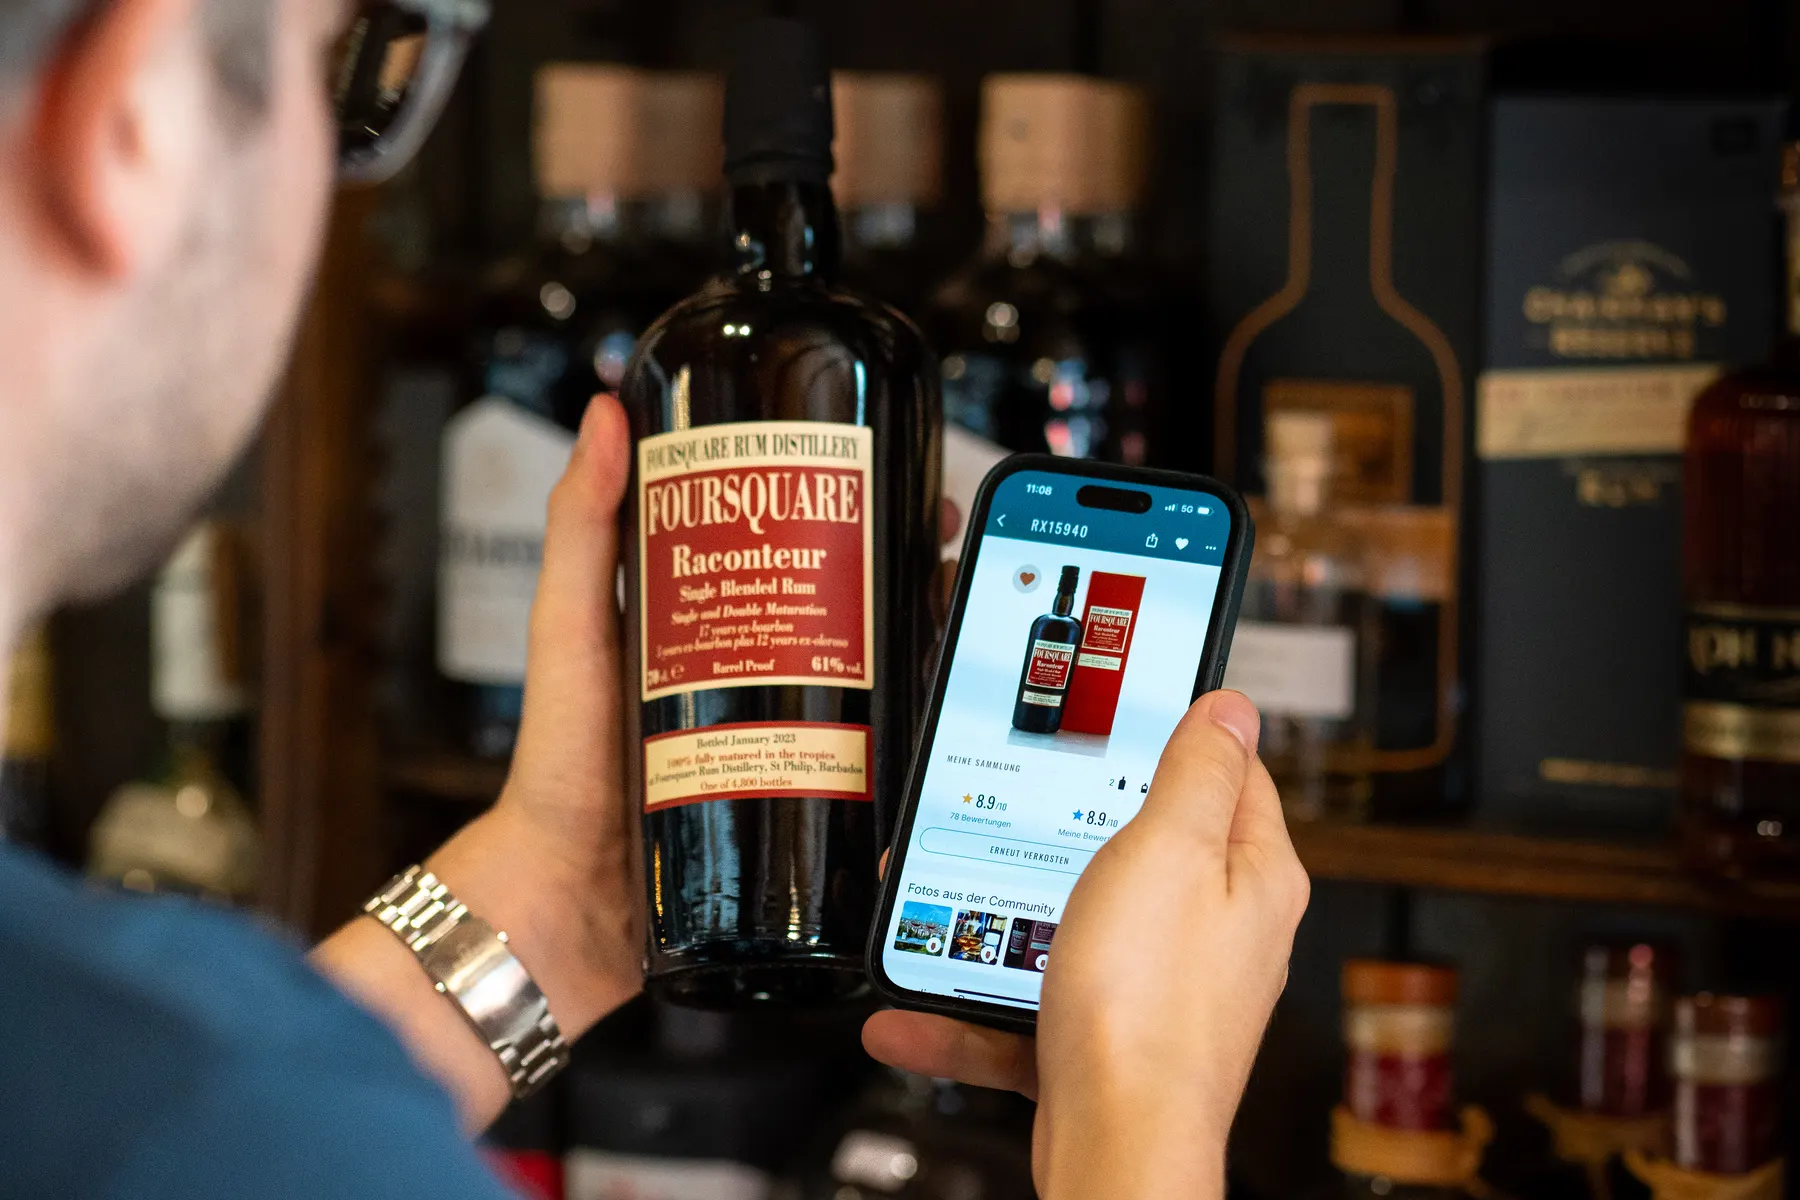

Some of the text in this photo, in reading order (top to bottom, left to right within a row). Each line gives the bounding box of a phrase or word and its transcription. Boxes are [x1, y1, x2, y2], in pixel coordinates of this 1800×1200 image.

[646, 432, 860, 471] FOURSQUARE RUM DISTILLERY
[1026, 483, 1053, 496] 11:08
[647, 472, 860, 536] FOURSQUARE
[1181, 504, 1194, 514] 5G
[1030, 518, 1089, 539] RX15940
[671, 543, 828, 579] Raconteur
[679, 577, 817, 605] Single Blended Rum
[700, 605, 722, 620] and
[723, 602, 763, 618] Double
[764, 602, 828, 617] Maturation
[733, 633, 756, 652] plus
[769, 635, 799, 650] years
[713, 658, 776, 675] Barrel Proof
[811, 656, 845, 673] 61%
[696, 733, 797, 749] Bottled January 2023
[695, 752, 715, 766] fully
[718, 749, 762, 762] matured
[765, 748, 775, 760] in
[779, 748, 796, 760] the
[799, 750, 836, 762] tropics
[946, 754, 1021, 773] MEINE SAMMLUNG
[699, 765, 720, 777] Rum
[770, 760, 780, 771] St
[819, 761, 863, 774] Barbados
[700, 779, 718, 791] One
[720, 778, 730, 789] of
[760, 776, 793, 788] bottles
[1108, 778, 1115, 787] 2
[950, 811, 1012, 829] 78 Bewertungen
[1057, 828, 1081, 839] Meine
[989, 845, 1070, 865] ERNEUT VERKOSTEN
[907, 882, 1056, 917] Fotos aus der Community
